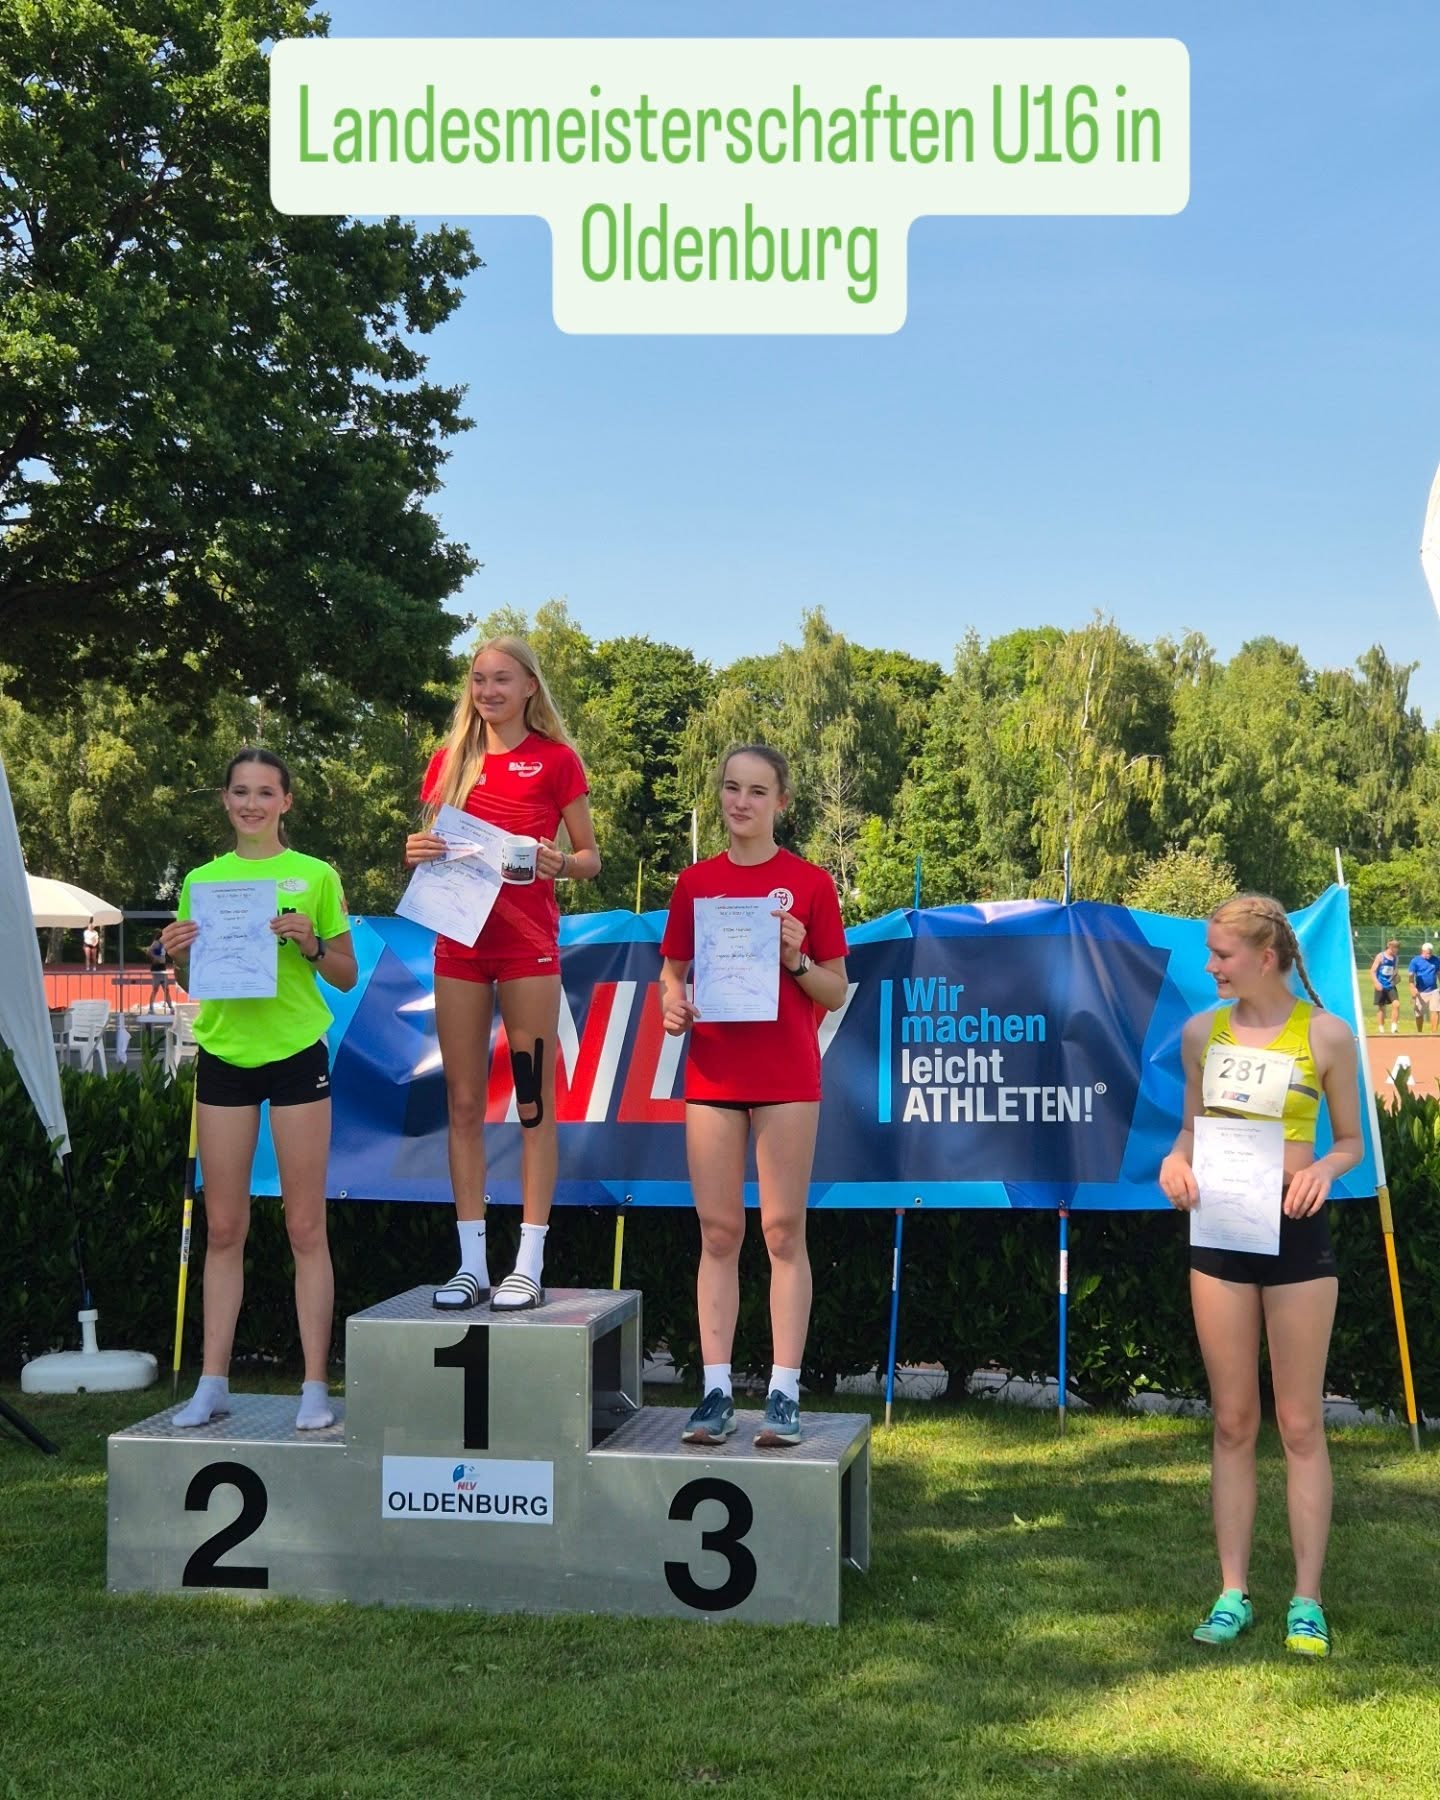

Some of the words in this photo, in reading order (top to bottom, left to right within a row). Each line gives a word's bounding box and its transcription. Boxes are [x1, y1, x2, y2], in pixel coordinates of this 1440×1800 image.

[903, 977, 964, 1012] Wir
[902, 1008, 1046, 1043] machen
[902, 1048, 1004, 1084] leicht
[1218, 1057, 1267, 1085] 281
[434, 1325, 489, 1450] 1
[388, 1491, 548, 1516] OLDENBURG
[456, 1481, 478, 1491] NLV
[182, 1462, 268, 1589] 2
[664, 1478, 757, 1611] 3
